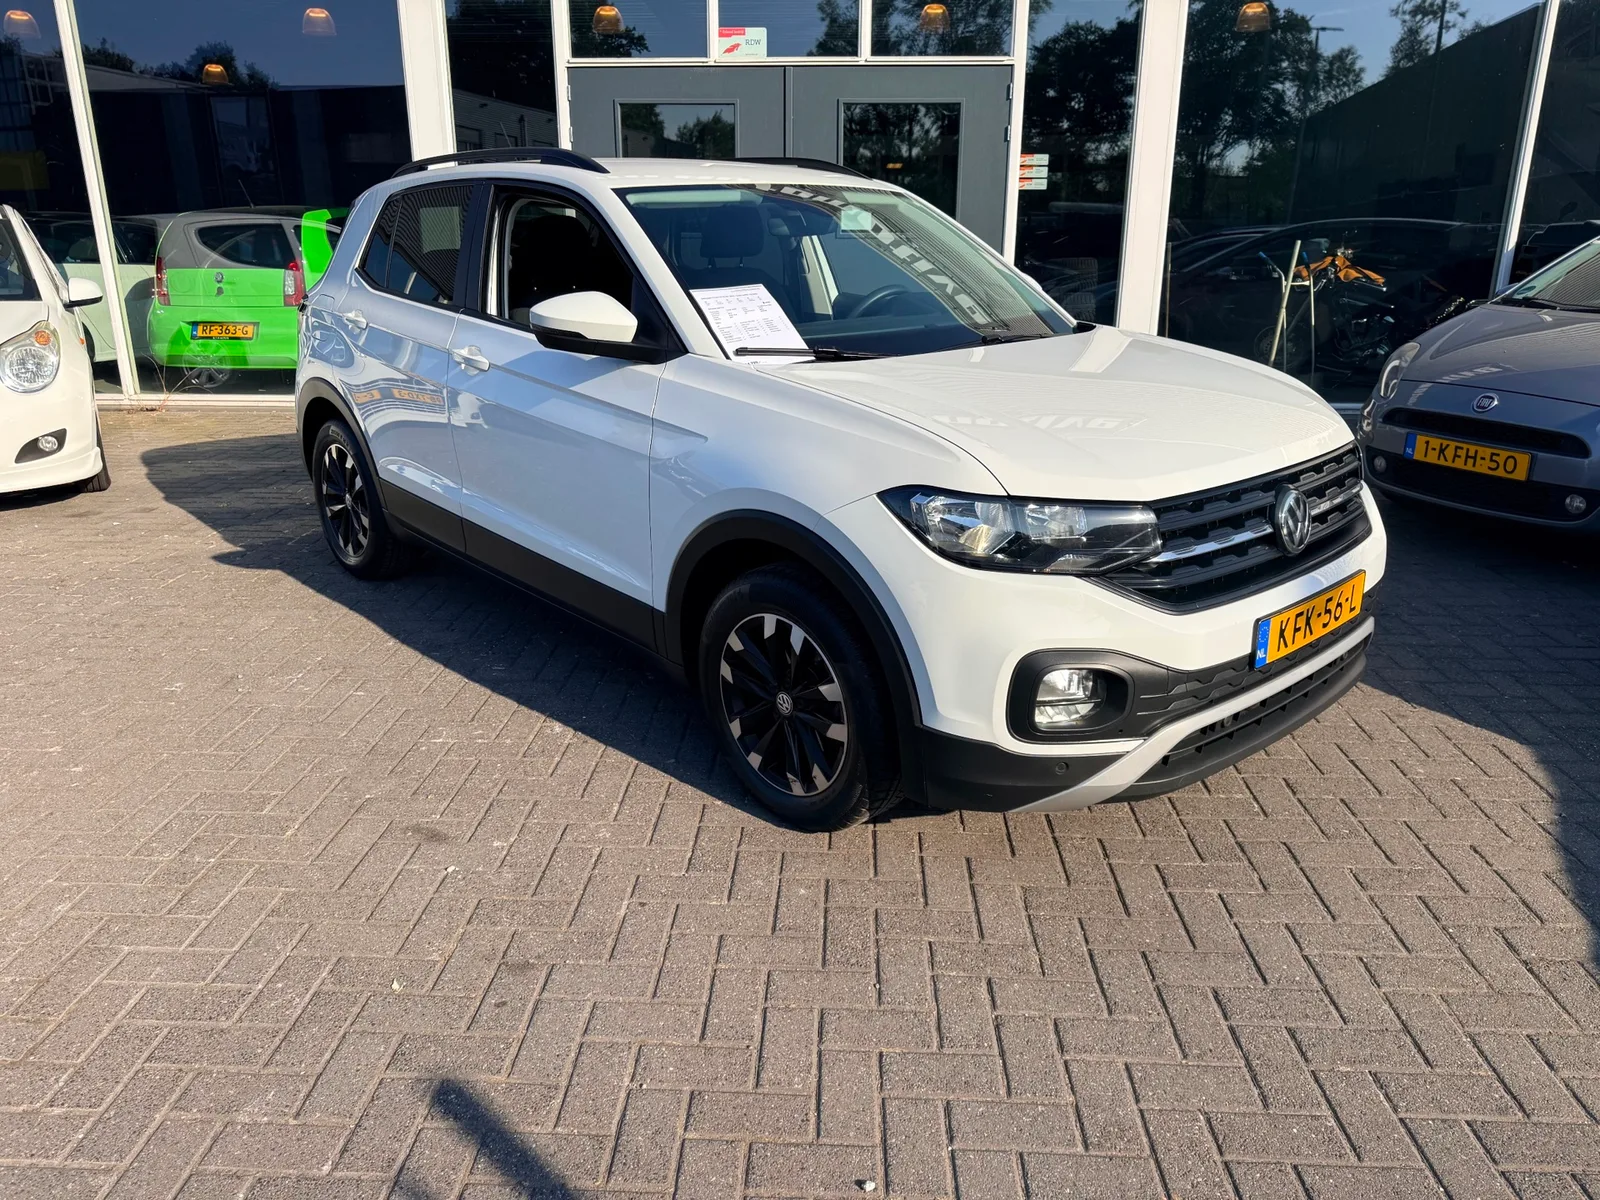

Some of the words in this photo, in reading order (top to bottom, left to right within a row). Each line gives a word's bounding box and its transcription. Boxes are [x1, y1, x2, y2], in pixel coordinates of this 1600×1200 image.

[201, 324, 249, 336] RF-363-G
[1477, 397, 1495, 408] FIAT
[1423, 440, 1518, 475] 1-KFH-50
[1256, 648, 1267, 660] NL
[1276, 584, 1357, 653] KFK-56-L
